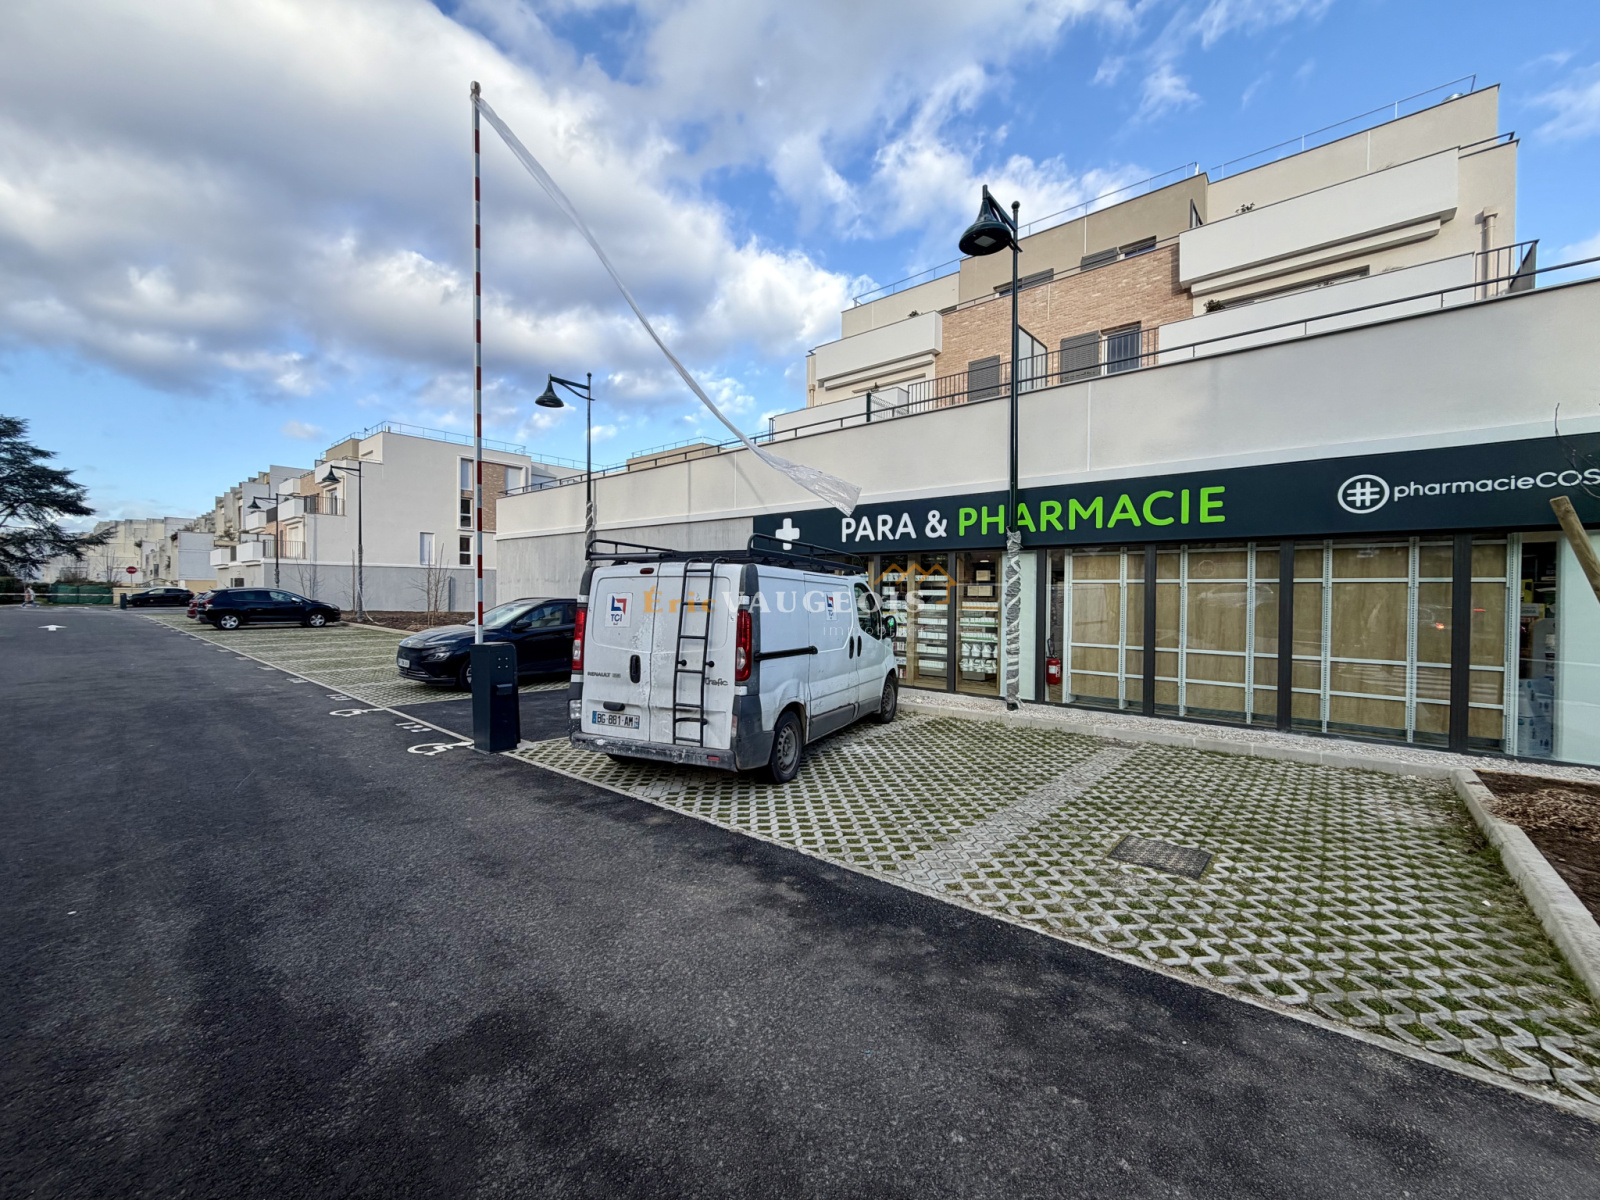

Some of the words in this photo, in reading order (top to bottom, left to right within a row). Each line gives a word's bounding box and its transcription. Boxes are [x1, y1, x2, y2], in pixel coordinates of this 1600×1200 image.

[1394, 468, 1600, 502] pharmacieCOS
[840, 512, 917, 543] PARA
[924, 510, 947, 539] &
[957, 486, 1226, 537] PHARMACIE
[610, 613, 623, 622] TCI
[705, 677, 729, 687] Trafic
